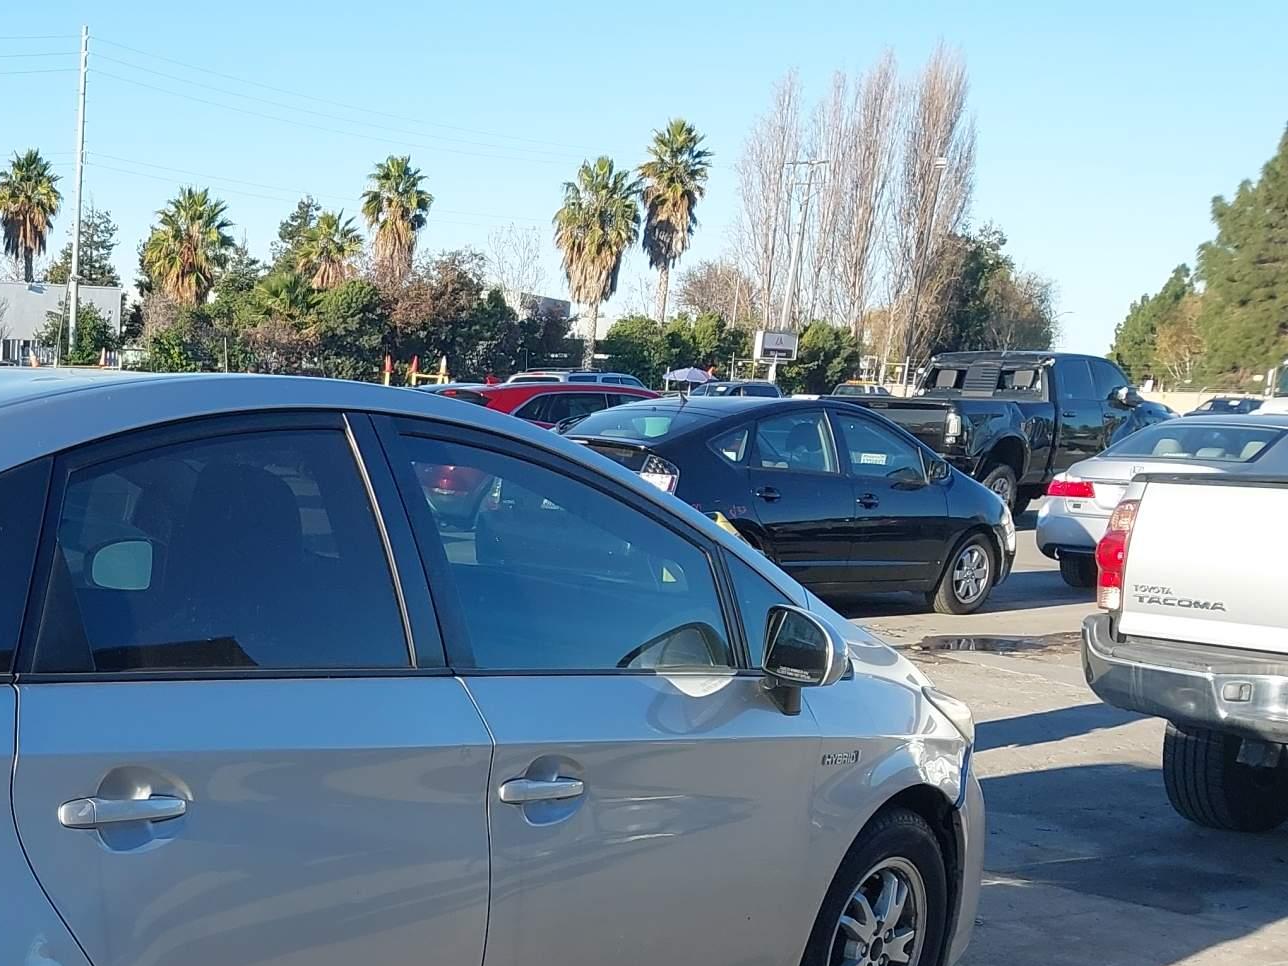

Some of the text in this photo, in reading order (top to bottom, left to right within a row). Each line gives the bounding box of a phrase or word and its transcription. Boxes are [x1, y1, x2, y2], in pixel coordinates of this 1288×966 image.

[1132, 584, 1173, 595] TOYOTA
[1132, 594, 1227, 612] TACOMA
[823, 751, 858, 766] HYBRID
